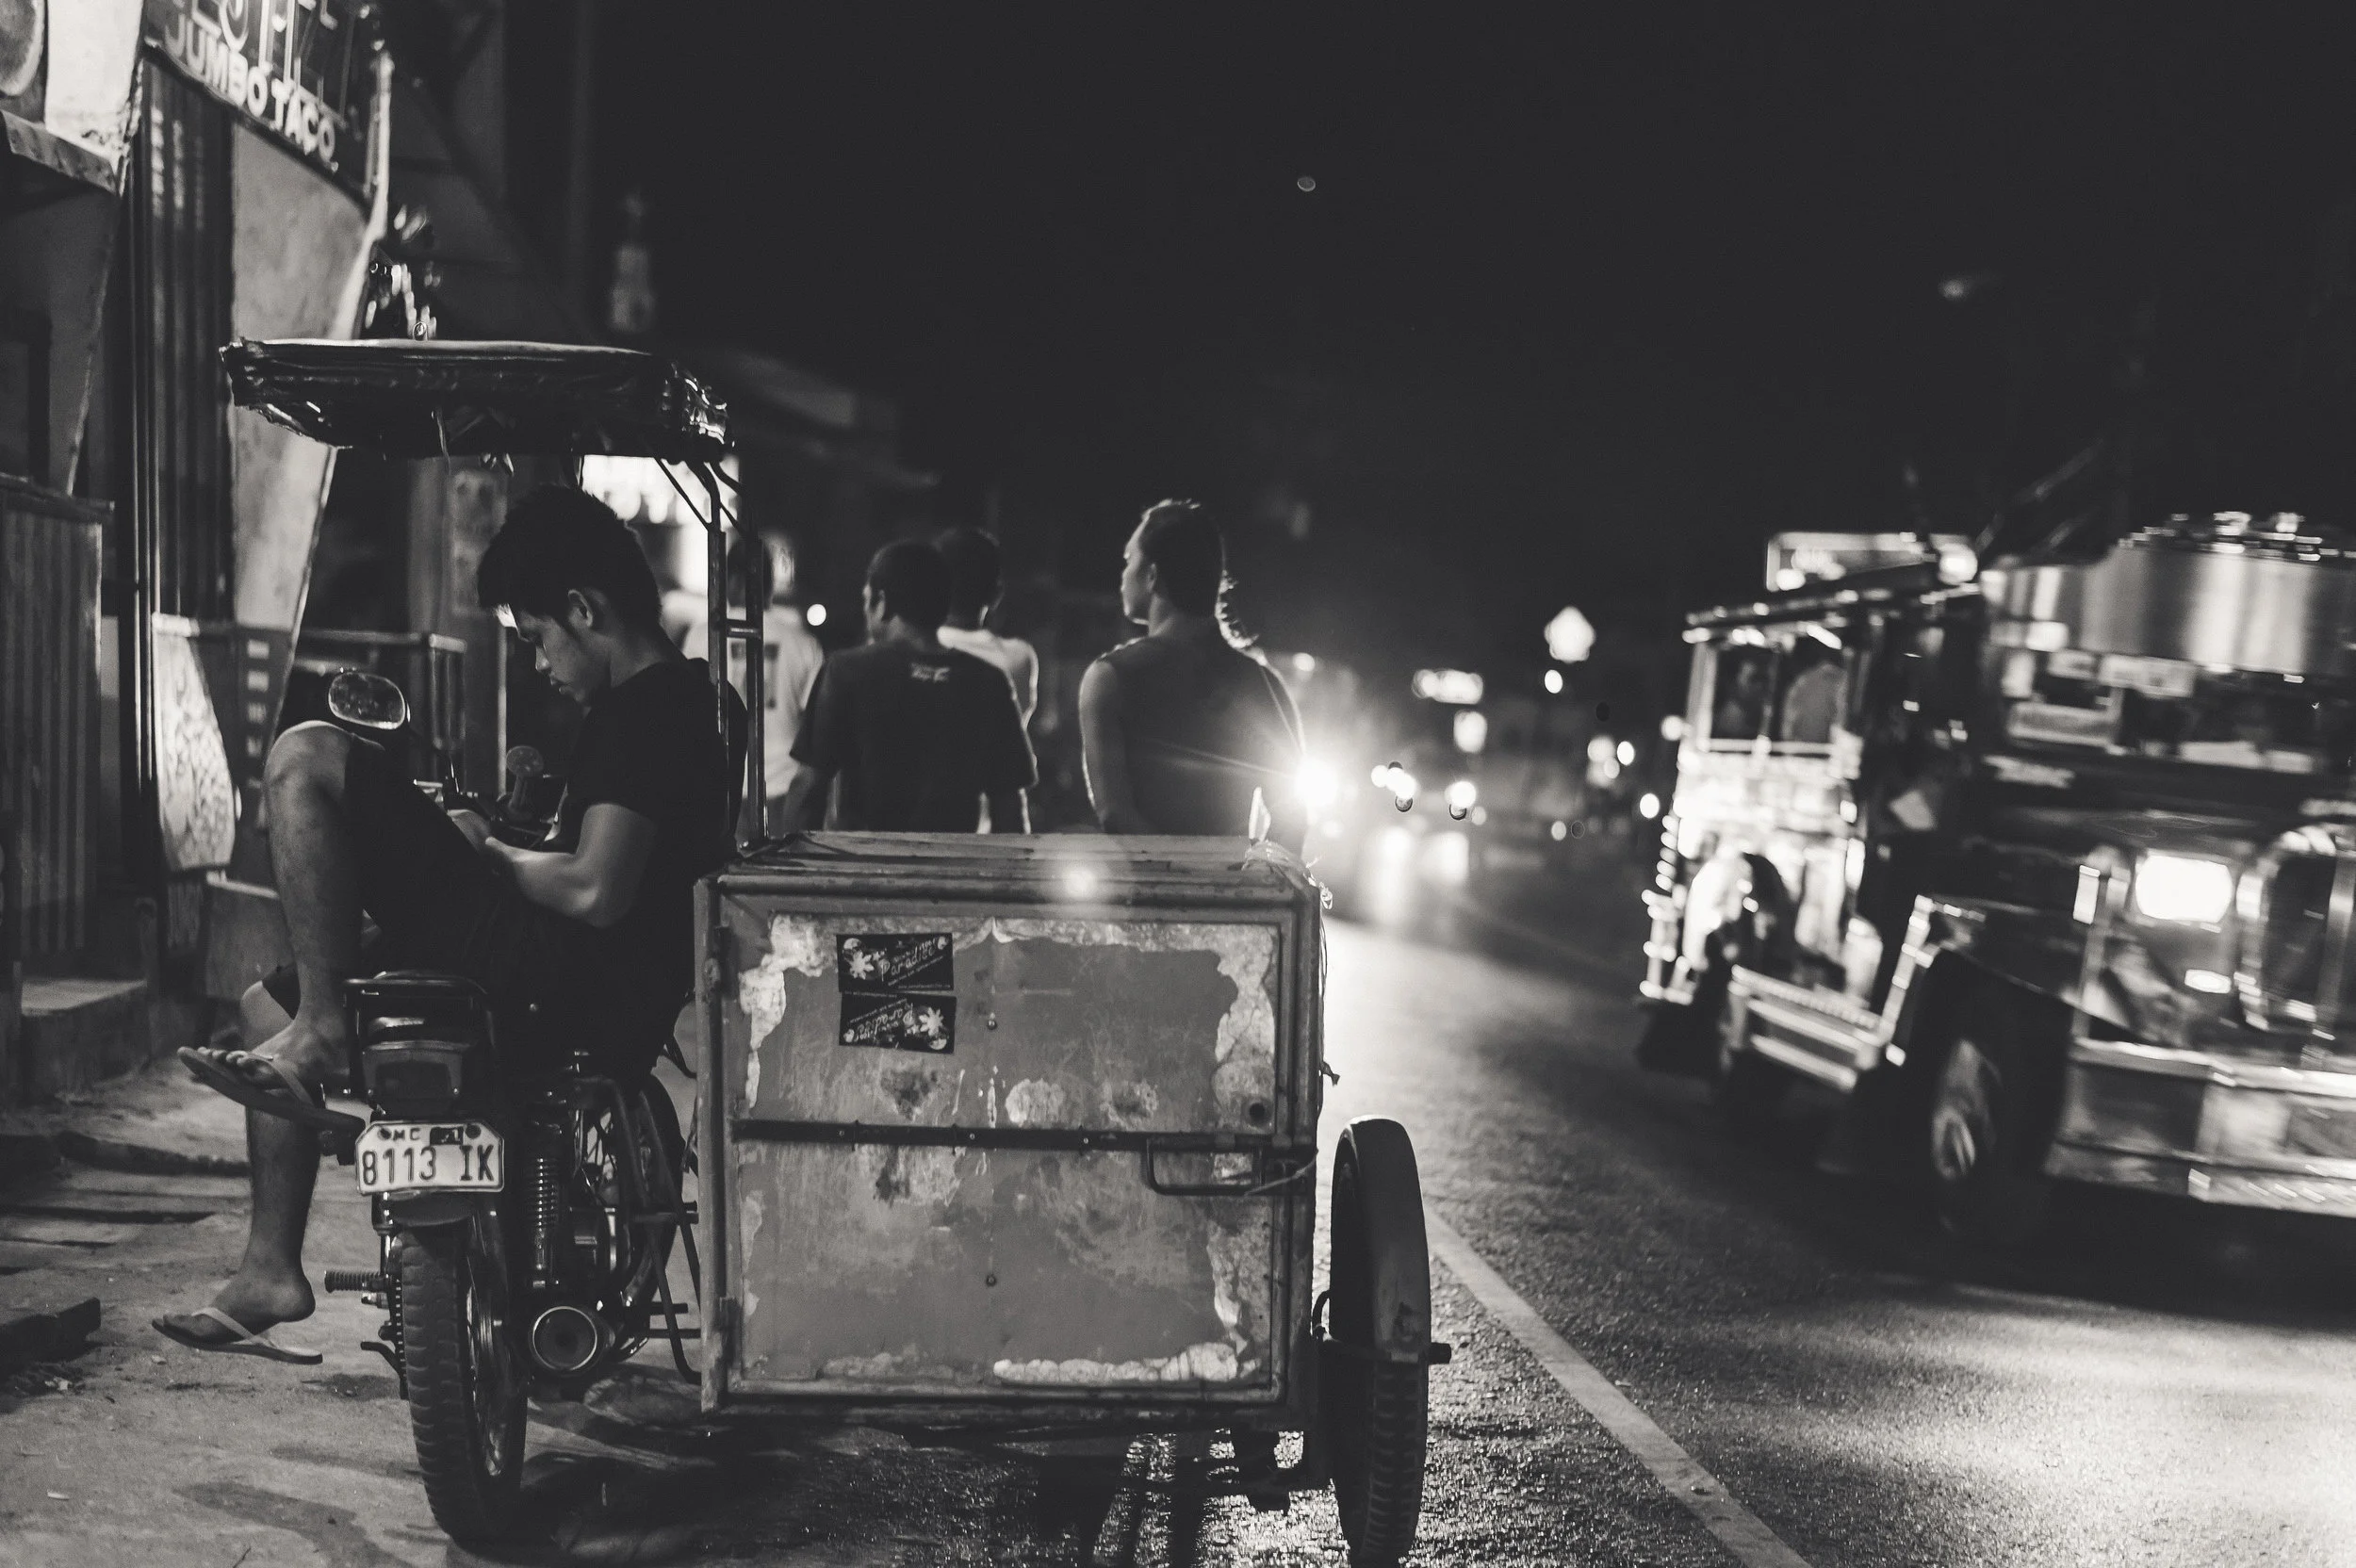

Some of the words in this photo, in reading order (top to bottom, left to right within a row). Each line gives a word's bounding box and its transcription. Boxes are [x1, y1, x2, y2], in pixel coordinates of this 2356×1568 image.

[165, 13, 268, 118] JUMBO
[271, 78, 336, 164] TACO
[393, 1127, 421, 1141] MC
[362, 1146, 437, 1185] 8113
[460, 1144, 495, 1182] IK
